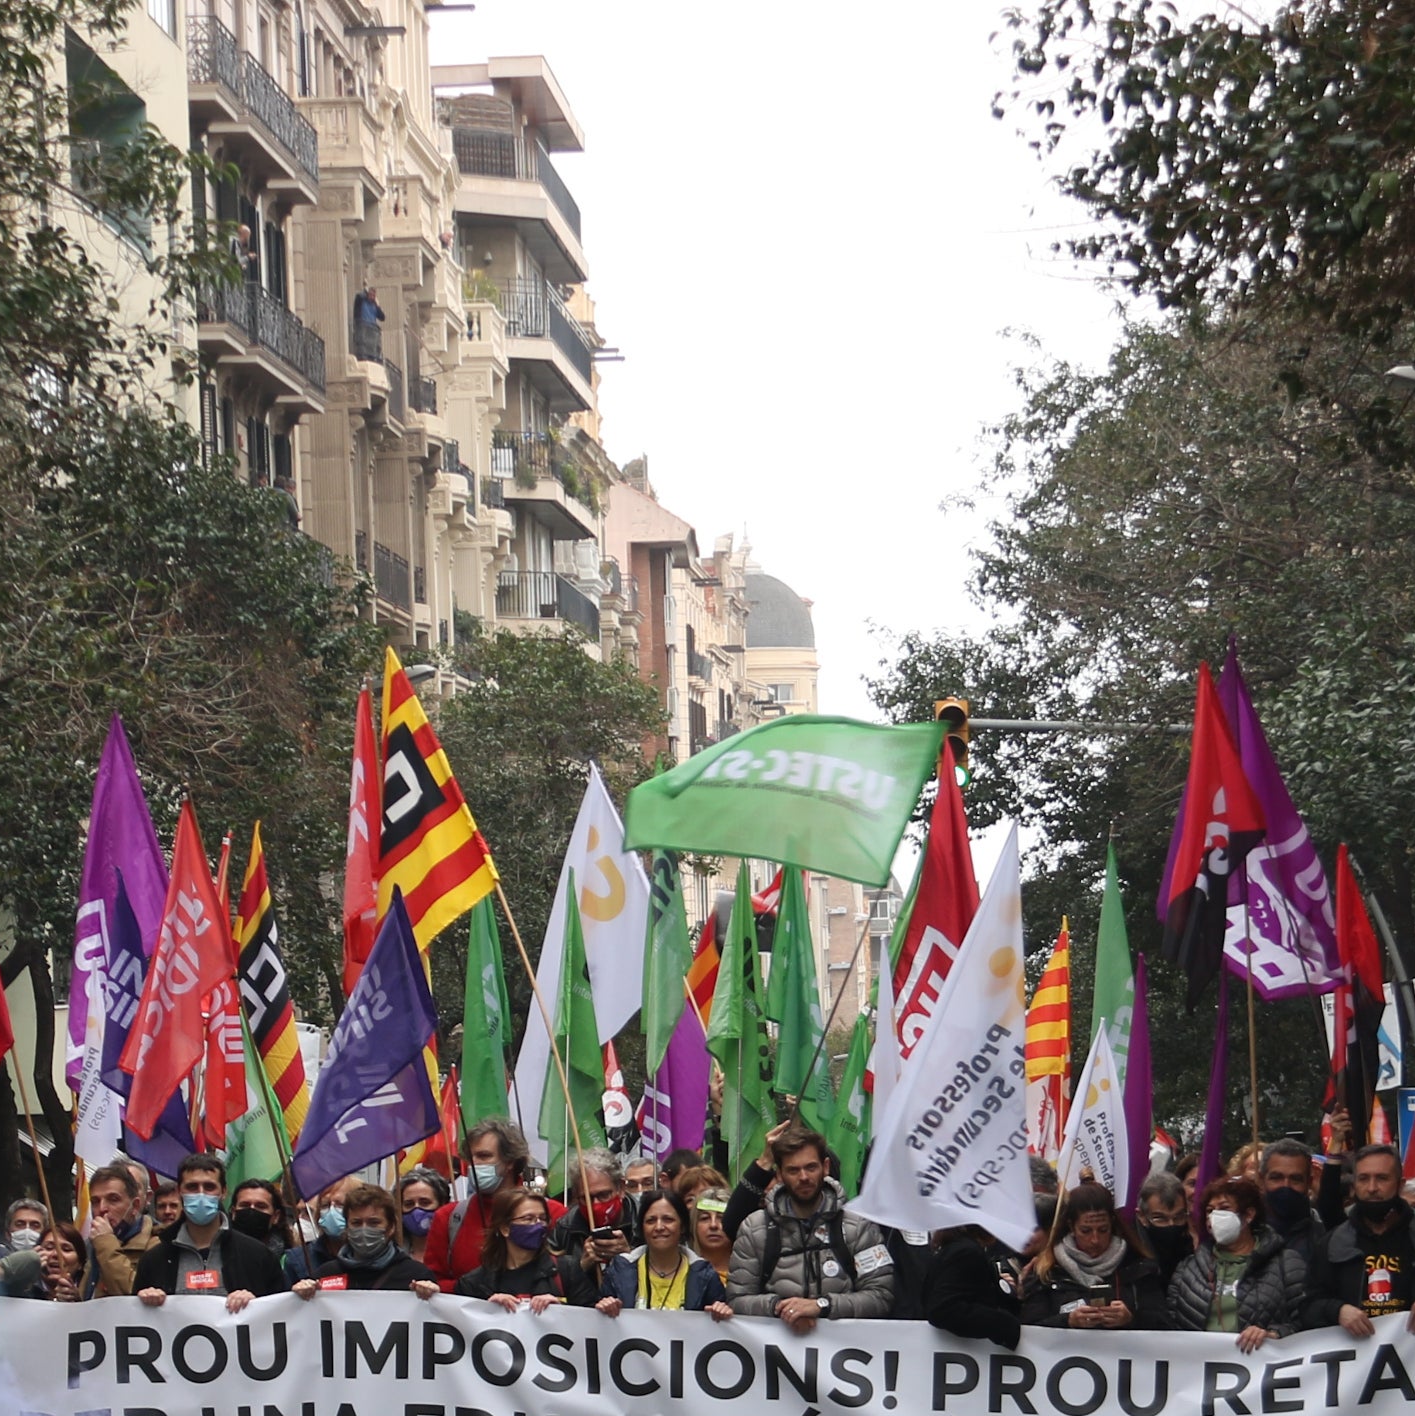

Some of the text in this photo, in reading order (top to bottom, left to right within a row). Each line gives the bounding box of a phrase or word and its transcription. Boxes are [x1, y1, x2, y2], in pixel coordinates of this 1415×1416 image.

[1084, 1118, 1096, 1135] de
[1365, 1254, 1401, 1273] SOS
[1369, 1292, 1391, 1302] CGT
[68, 1320, 288, 1390] PROU
[320, 1319, 900, 1410] IMPOSICIONS!
